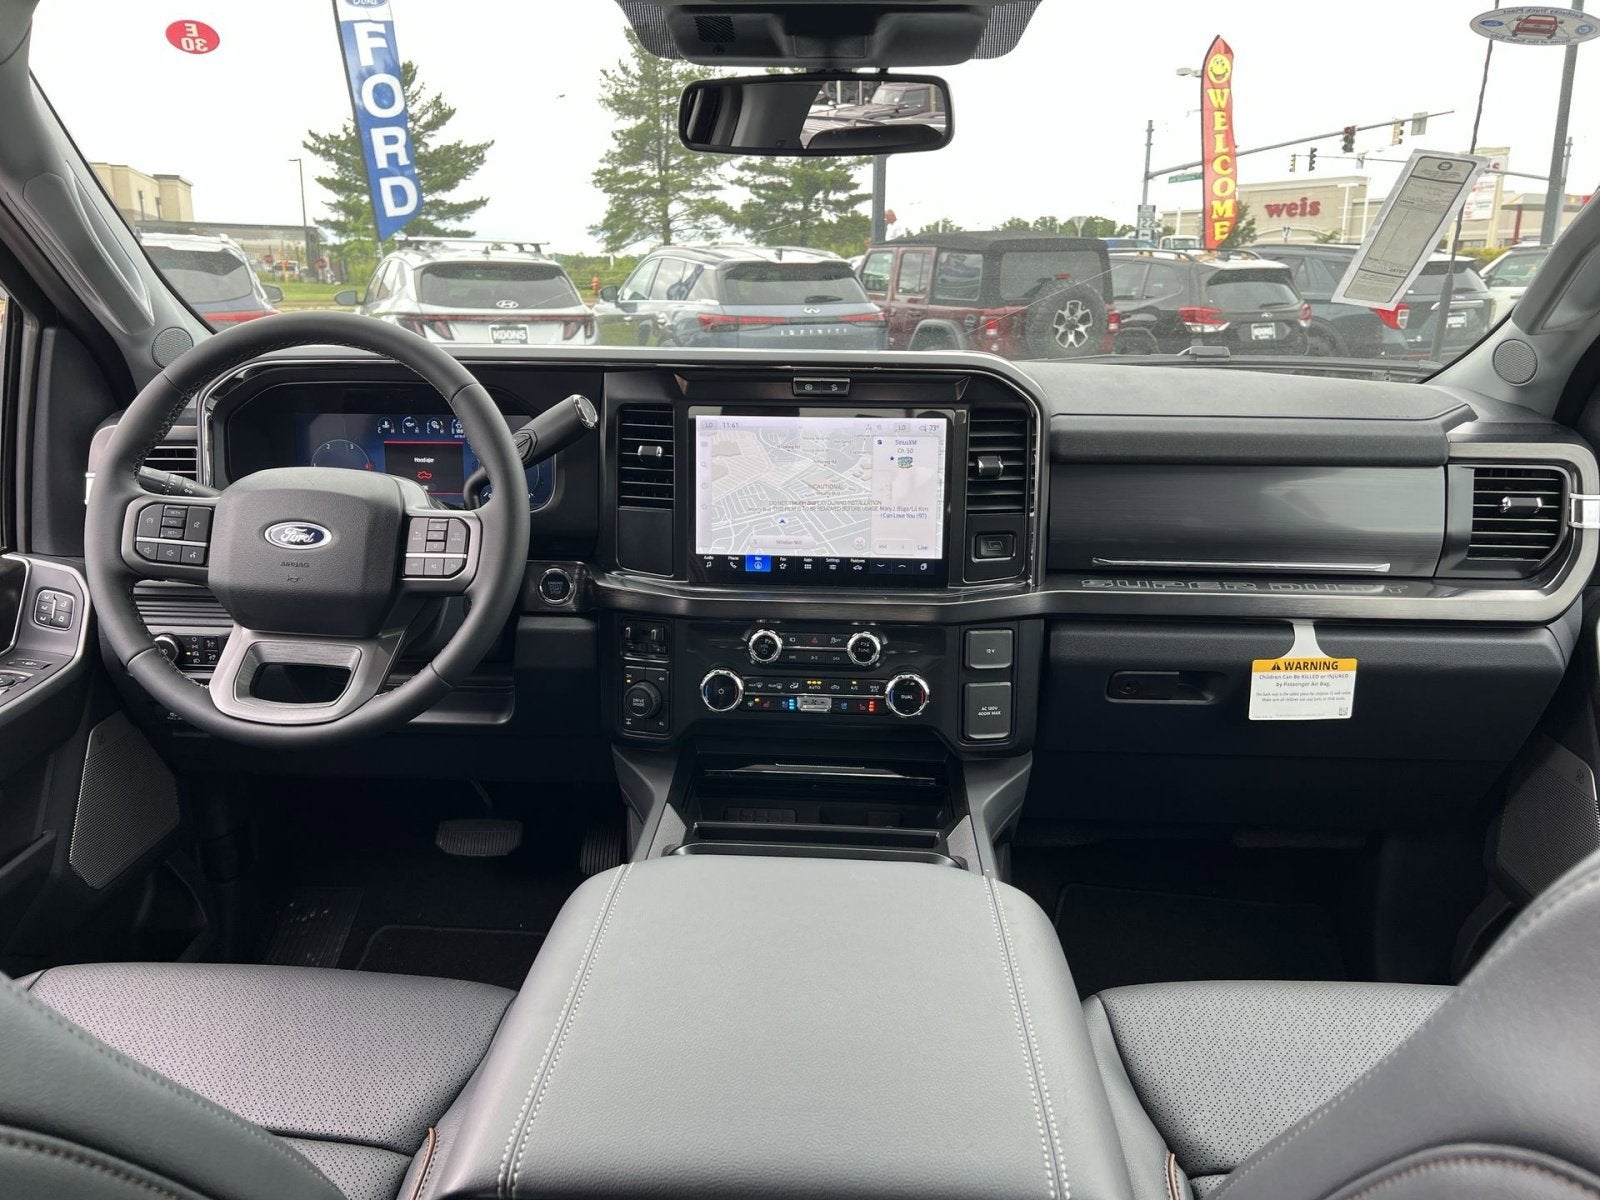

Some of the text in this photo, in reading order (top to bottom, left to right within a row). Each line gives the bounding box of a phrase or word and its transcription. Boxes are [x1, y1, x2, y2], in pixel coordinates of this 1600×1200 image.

[354, 22, 418, 217] FORD
[1207, 88, 1236, 241] WELCOME
[1264, 197, 1321, 219] weis
[493, 330, 526, 340] KOONS
[780, 328, 847, 336] INFINITI
[281, 527, 315, 543] Ford
[1081, 578, 1258, 592] SUPER
[1284, 661, 1339, 671] WARNING
